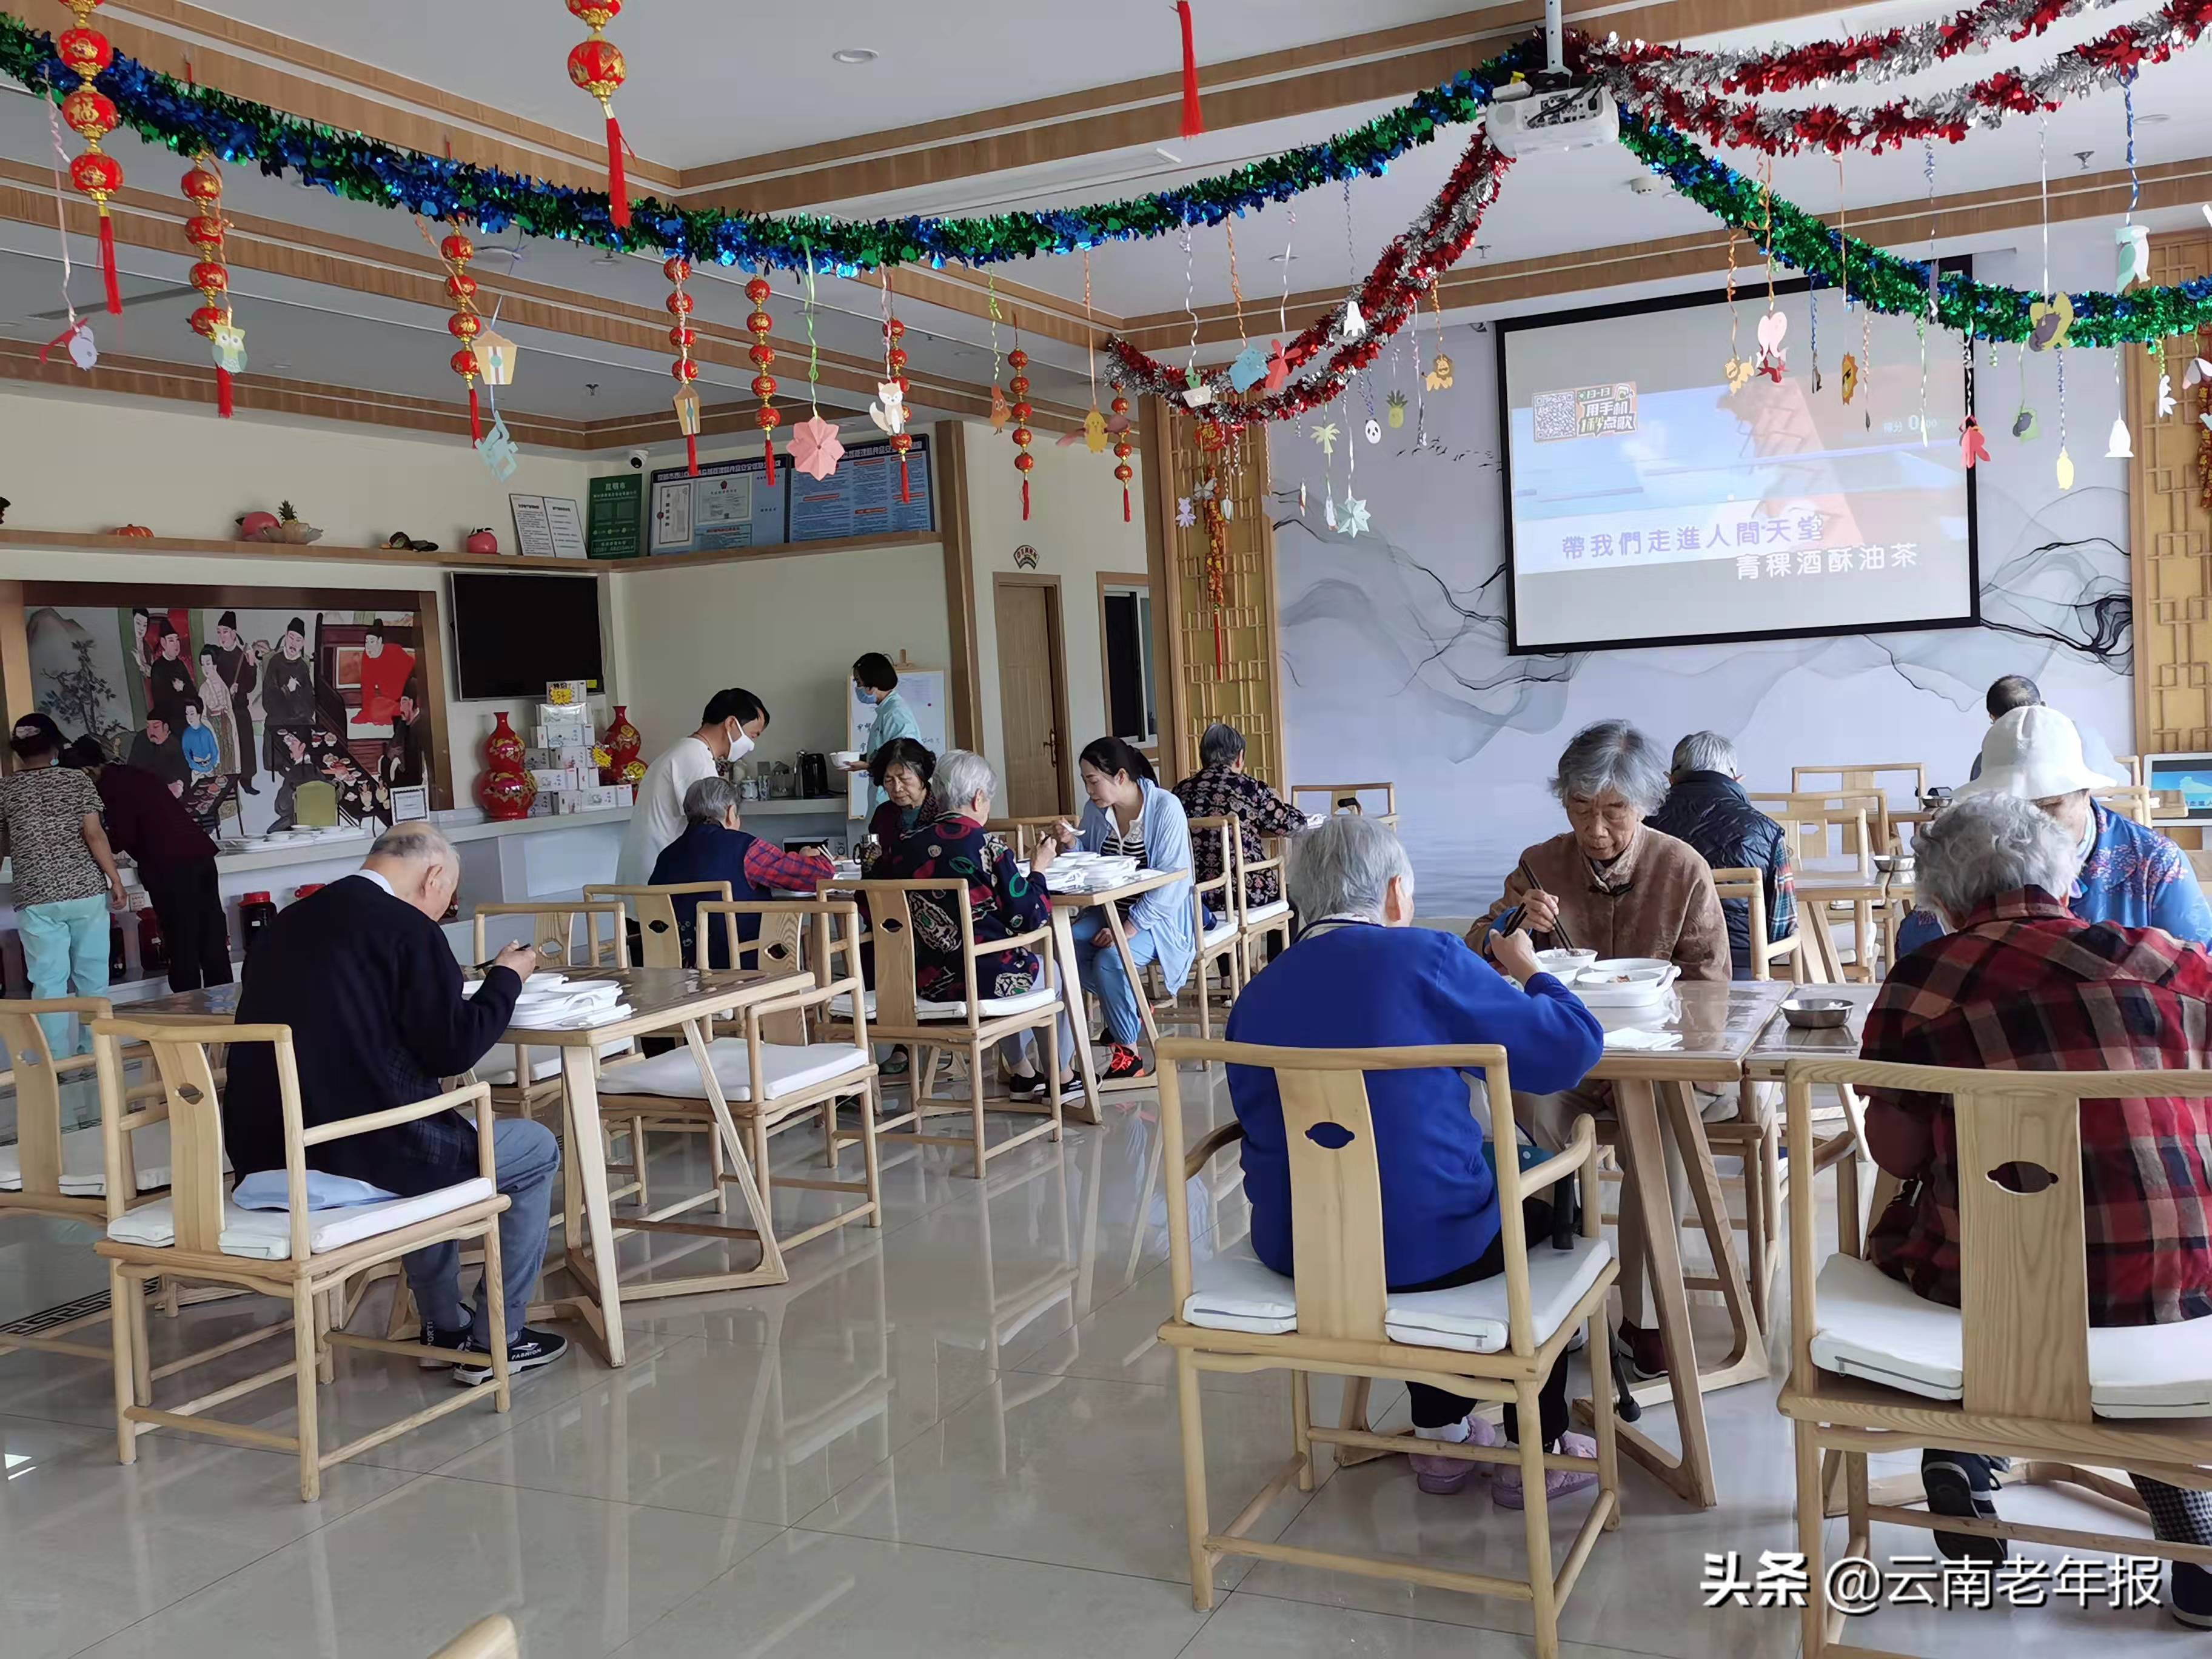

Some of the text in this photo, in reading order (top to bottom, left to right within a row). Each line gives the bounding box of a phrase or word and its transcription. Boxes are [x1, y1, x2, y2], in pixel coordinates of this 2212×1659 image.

[1586, 401, 1628, 417] 用手机
[1581, 415, 1634, 433] 1秒点歌
[1562, 515, 1826, 559] 帶我們走進人間天堂
[1736, 543, 1918, 580] 青稞酒酥油茶
[511, 1348, 542, 1361] FASHION
